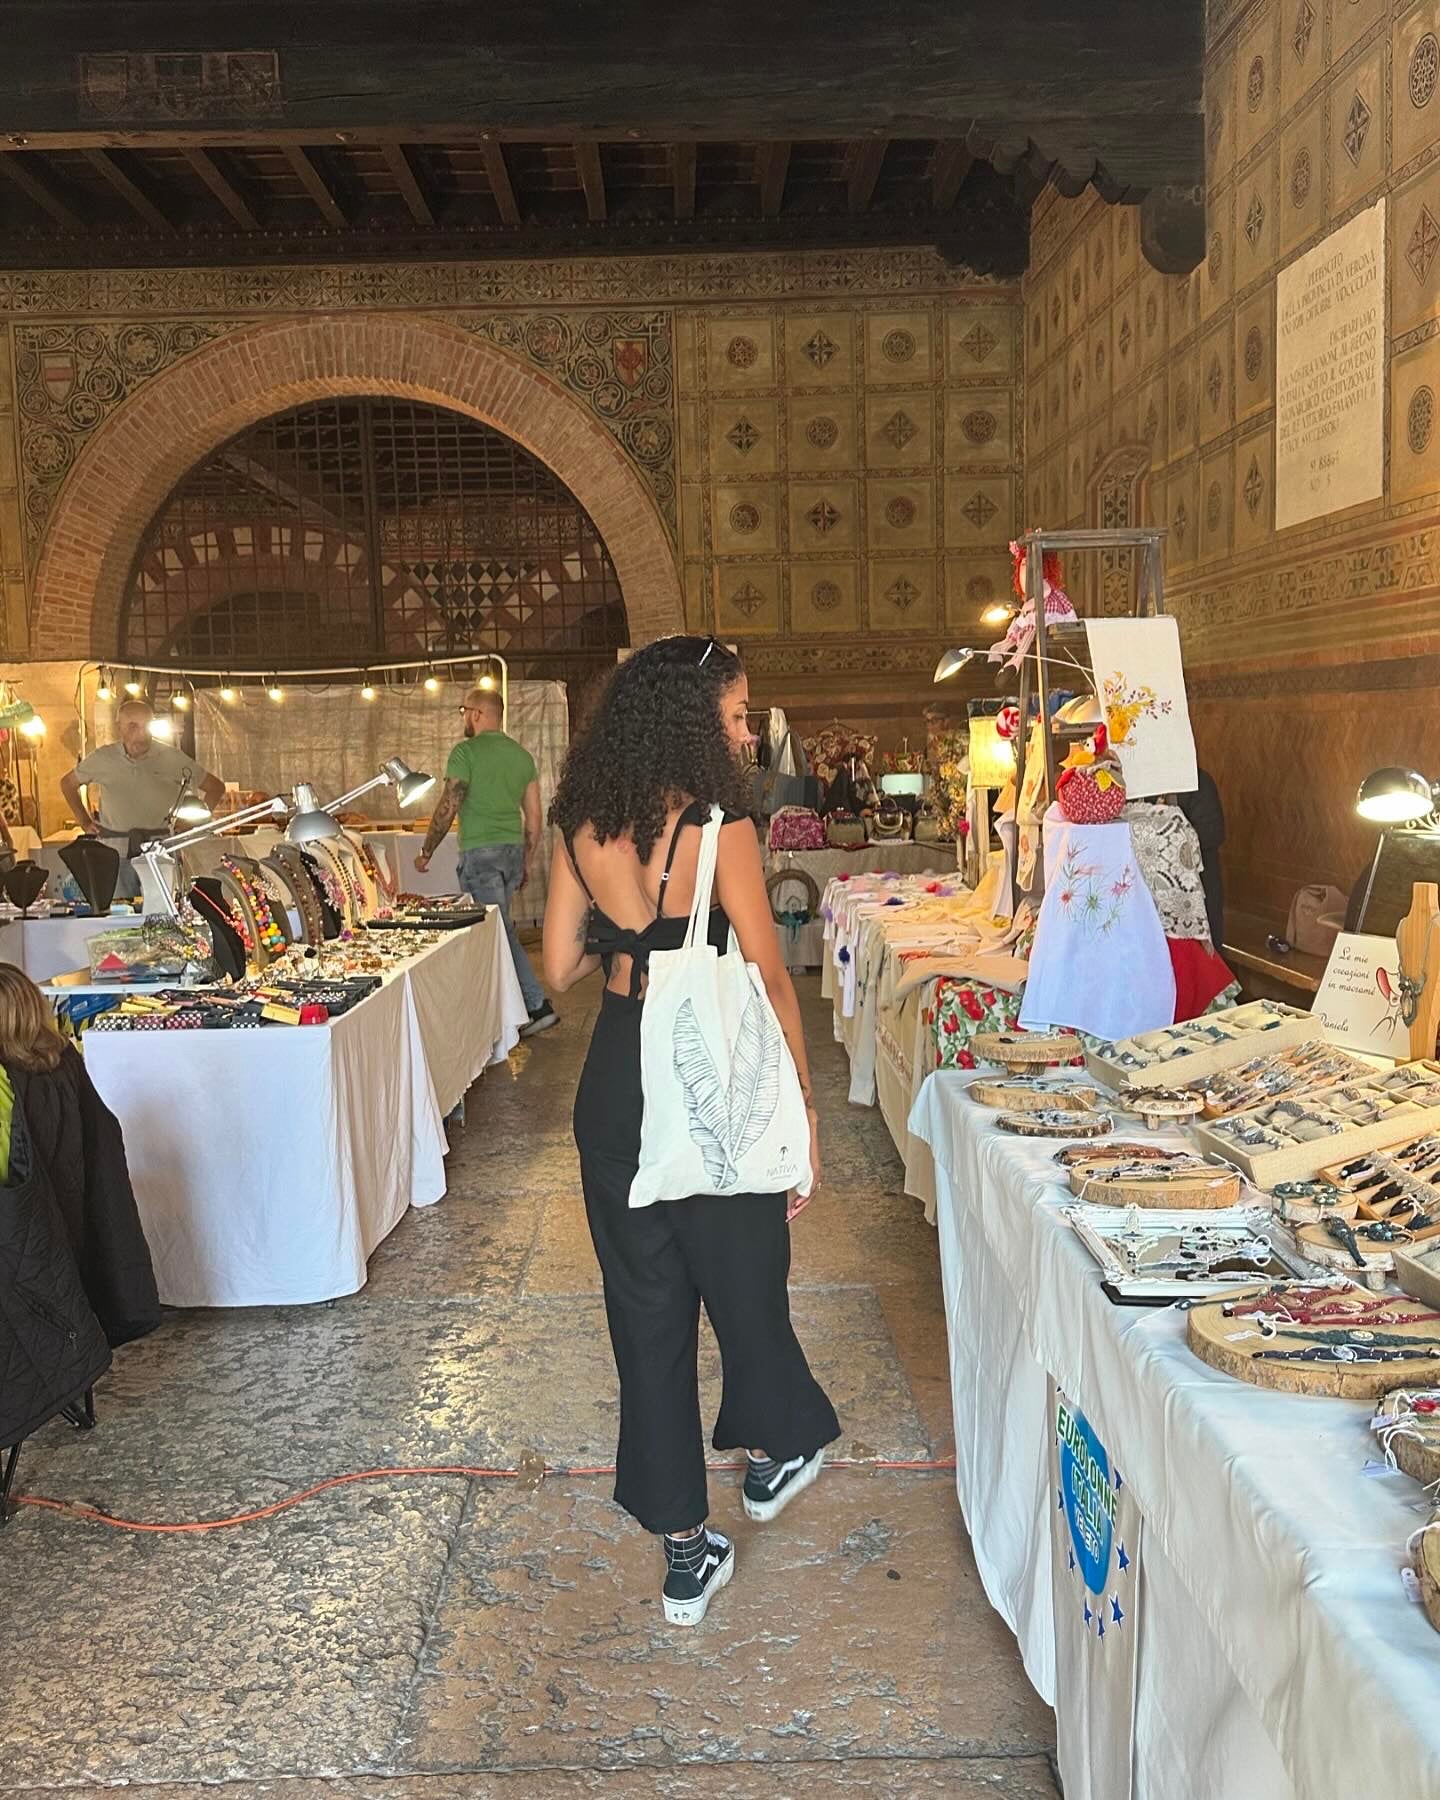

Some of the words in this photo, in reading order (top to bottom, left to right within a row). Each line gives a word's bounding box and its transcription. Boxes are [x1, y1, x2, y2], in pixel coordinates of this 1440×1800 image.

[1332, 967, 1370, 981] creazioni
[1339, 946, 1351, 960] Le
[1354, 955, 1369, 963] mie
[1071, 1462, 1103, 1546] ITALIA
[1074, 1503, 1099, 1564] VEETO
